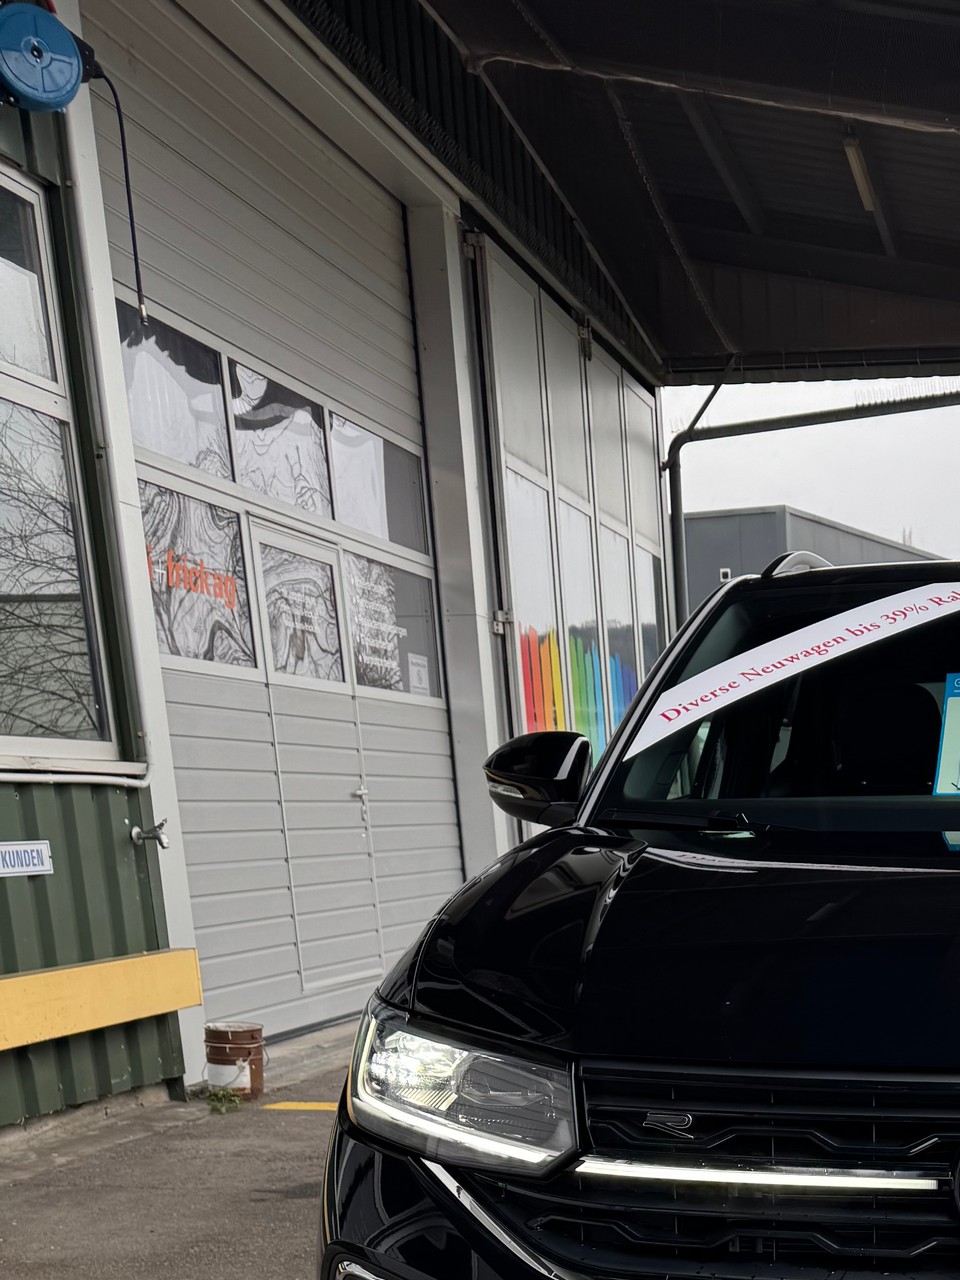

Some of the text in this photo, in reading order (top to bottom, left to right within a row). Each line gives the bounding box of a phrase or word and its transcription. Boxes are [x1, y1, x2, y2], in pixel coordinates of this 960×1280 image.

[659, 680, 741, 722] Diverse
[738, 635, 848, 682] Neuwagen
[845, 623, 881, 637] bis
[880, 603, 929, 625] 39%
[0, 849, 44, 868] KUNDEN
